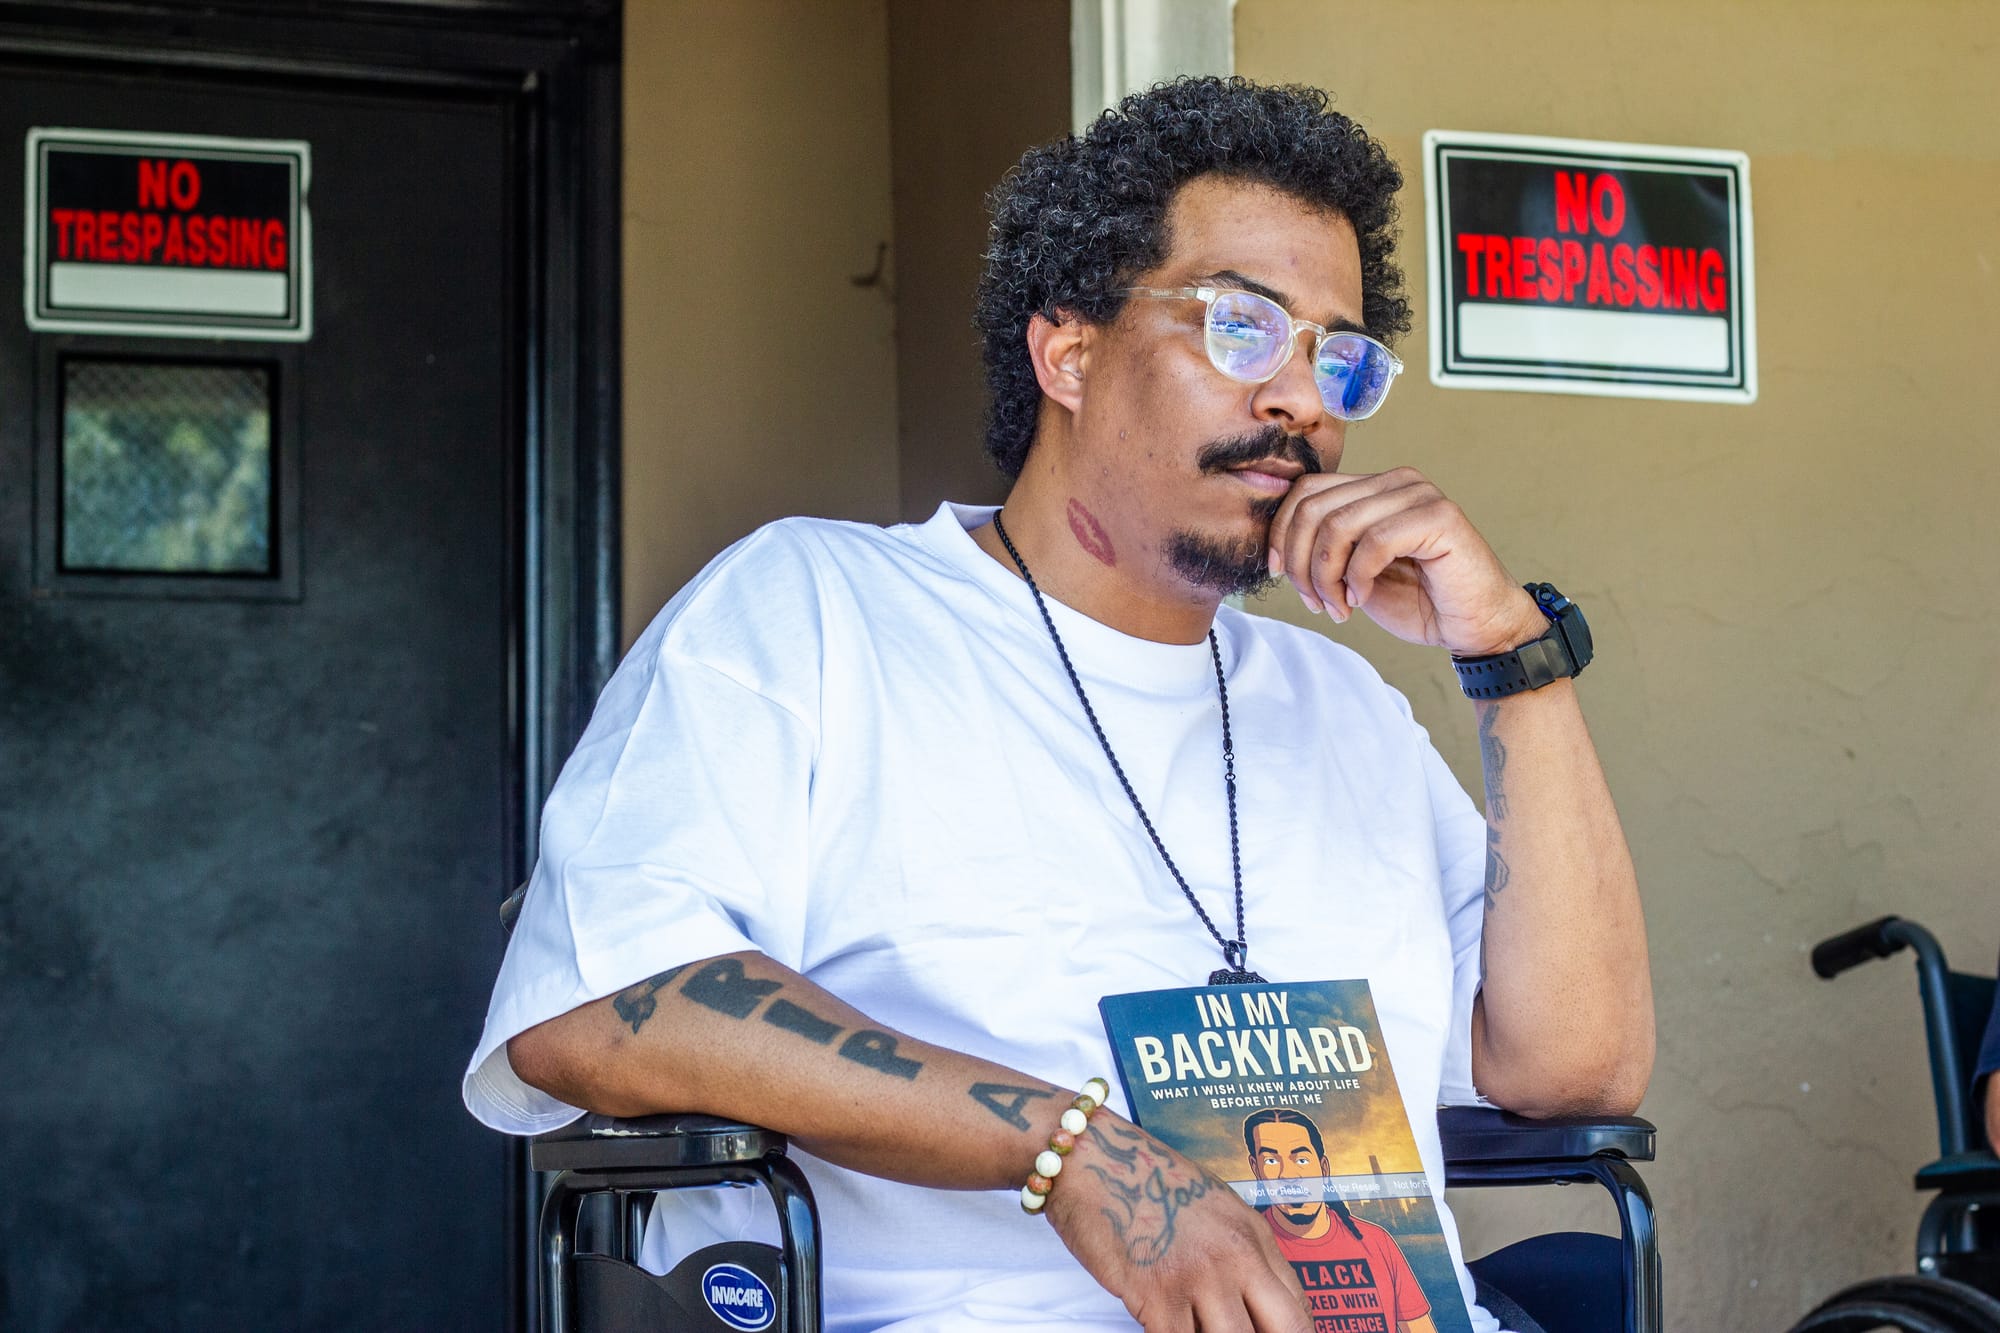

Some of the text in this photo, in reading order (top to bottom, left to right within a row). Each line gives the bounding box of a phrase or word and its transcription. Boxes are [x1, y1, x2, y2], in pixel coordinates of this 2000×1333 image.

[138, 159, 200, 210] NO
[1554, 171, 1626, 237] NO
[52, 209, 287, 269] TRESPASSING
[1457, 233, 1727, 312] TRESPASSING
[1195, 991, 1291, 1028] IN MY
[1134, 1026, 1374, 1084] BACKYARD
[1151, 1078, 1361, 1100] WHAT I WISH I KNEW ABOUT LIFE
[1210, 1092, 1323, 1109] BEFORE IT HIT ME
[1301, 1263, 1370, 1287] LACK
[711, 1285, 764, 1308] INVACARE
[1308, 1292, 1379, 1311] XED WITH
[1314, 1316, 1385, 1333] CELLENCE
